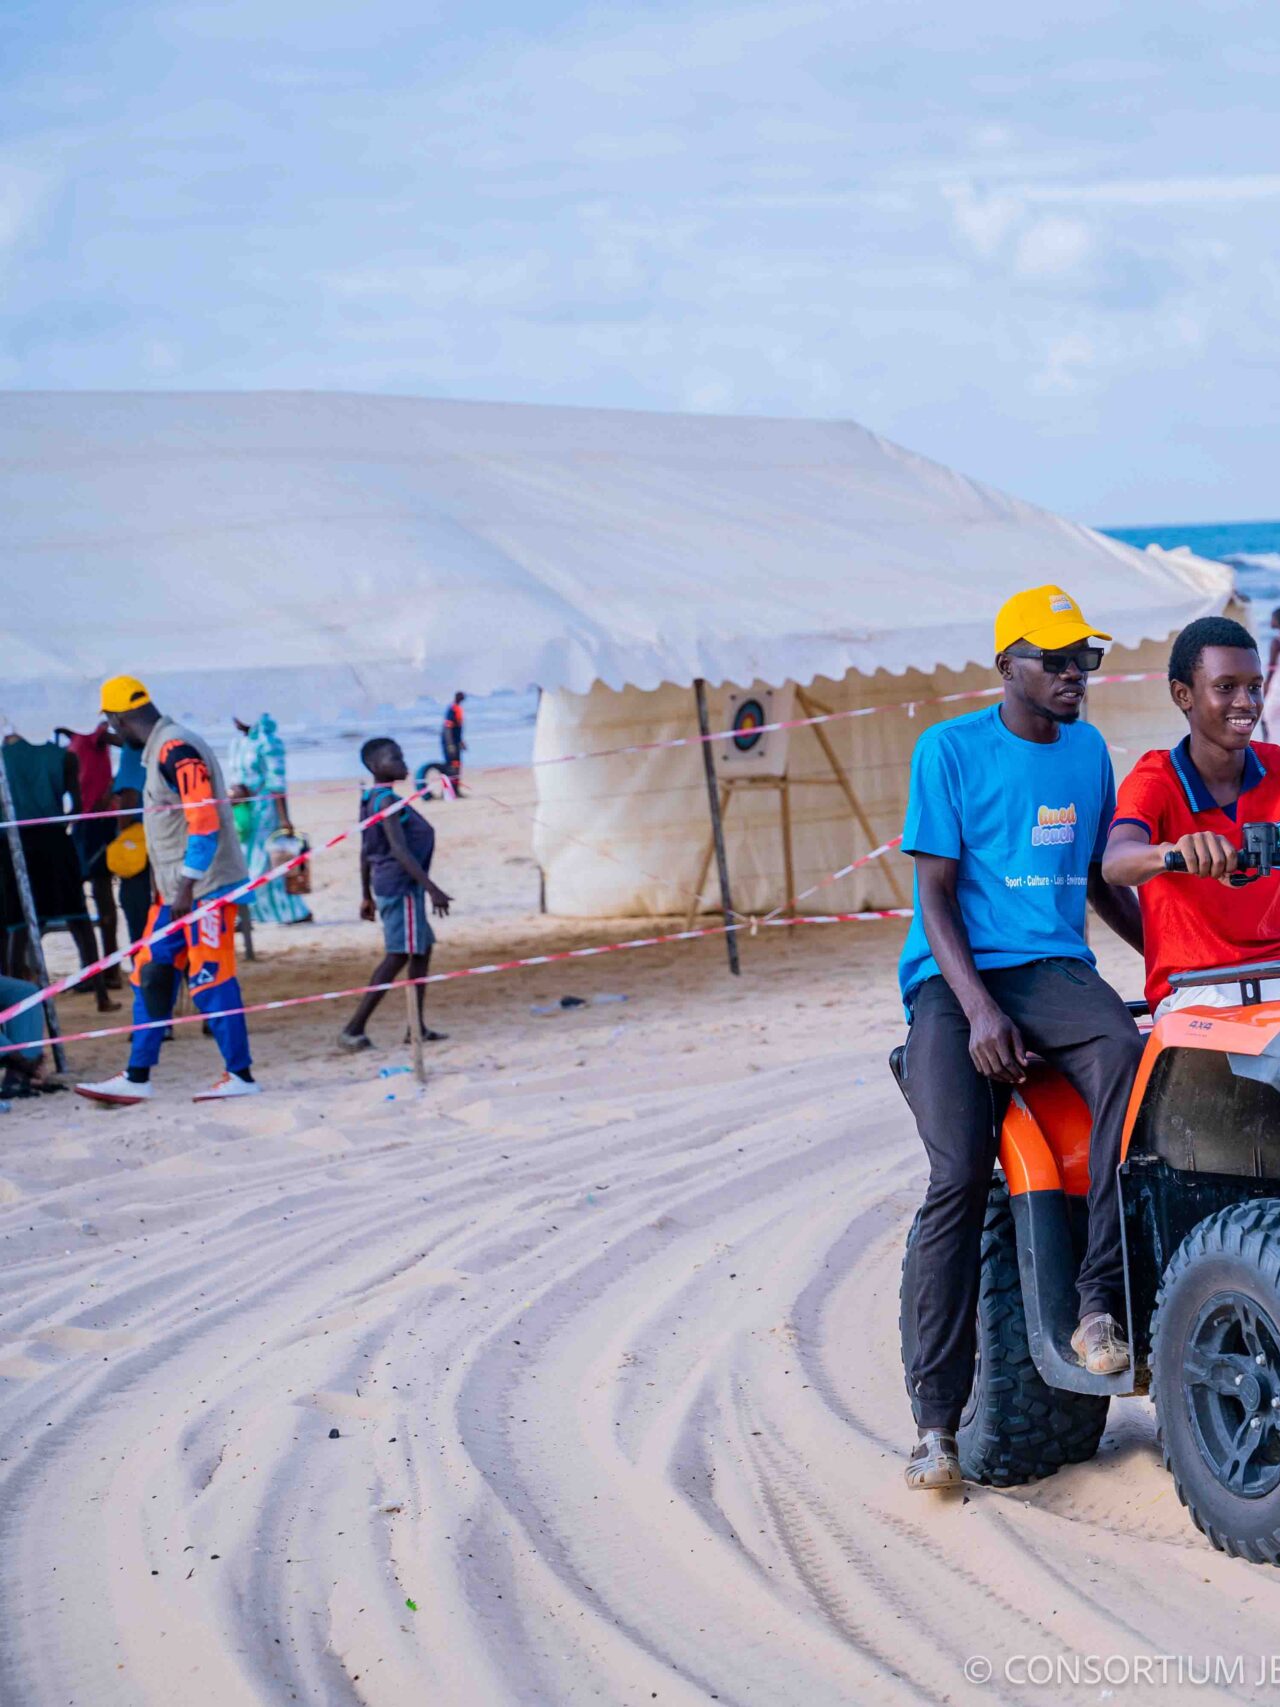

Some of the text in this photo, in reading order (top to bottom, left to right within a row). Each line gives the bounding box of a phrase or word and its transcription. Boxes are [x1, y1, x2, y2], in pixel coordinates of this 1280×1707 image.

[1032, 826, 1074, 846] Beach
[1005, 876, 1023, 889] Sport
[1027, 876, 1049, 887] Culture
